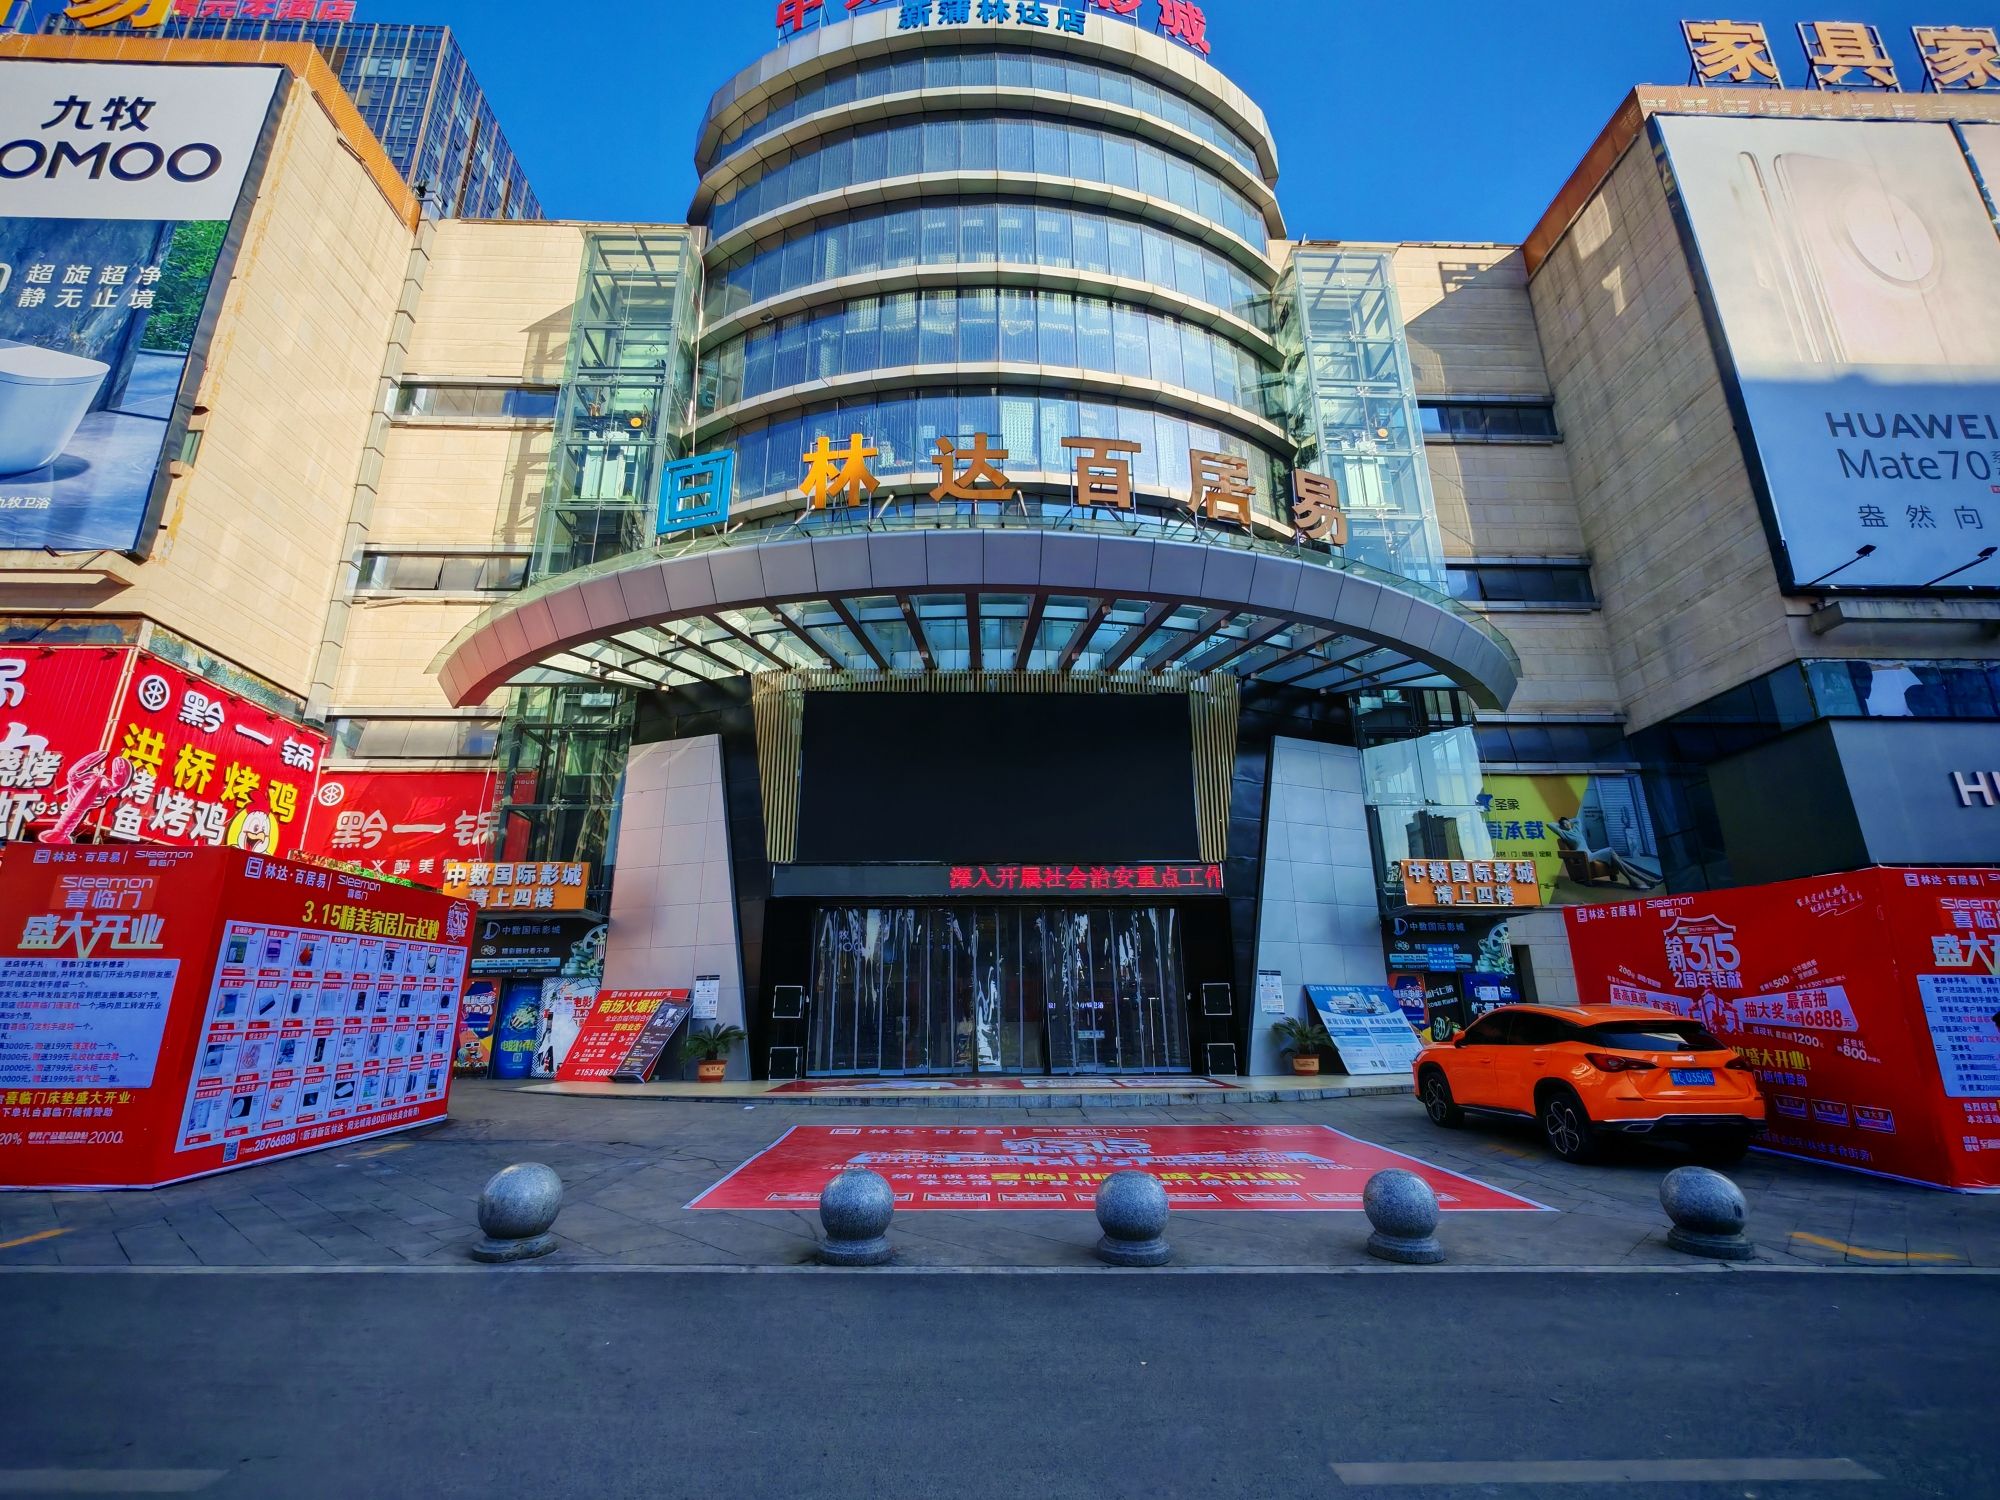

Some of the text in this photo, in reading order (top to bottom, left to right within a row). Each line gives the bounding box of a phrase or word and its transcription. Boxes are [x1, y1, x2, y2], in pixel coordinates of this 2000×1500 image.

[897, 0, 1086, 34] 新蒲林达店
[41, 95, 156, 131] 九牧
[26, 264, 162, 285] 超旋超净
[18, 288, 156, 309] 静无止境
[1825, 412, 1999, 440] HUAWEI
[801, 432, 1347, 546] 林达百居易
[1857, 504, 1984, 530] 盎然向
[178, 690, 316, 773] 黔一锅
[122, 722, 298, 824] 洪桥烤鸡
[1495, 798, 1520, 811] 圣象
[331, 809, 502, 850] 黔一锅
[134, 850, 194, 859] Sleemon
[60, 876, 154, 889] Sleemon
[337, 874, 381, 892] Sleemon
[446, 863, 583, 886] 中数国际影城
[1407, 861, 1537, 884] 中数国际影城
[64, 890, 142, 909] 喜临门
[468, 887, 555, 909] 请上四楼
[1434, 884, 1515, 905] 请上四楼
[1646, 896, 1695, 909] Sleemon
[1940, 898, 2000, 910] Sleem
[1952, 911, 2000, 928] 喜临
[17, 911, 165, 960] 盛大开业
[1744, 1001, 1785, 1019] 抽大奖
[1787, 990, 1828, 1010] 最高抽
